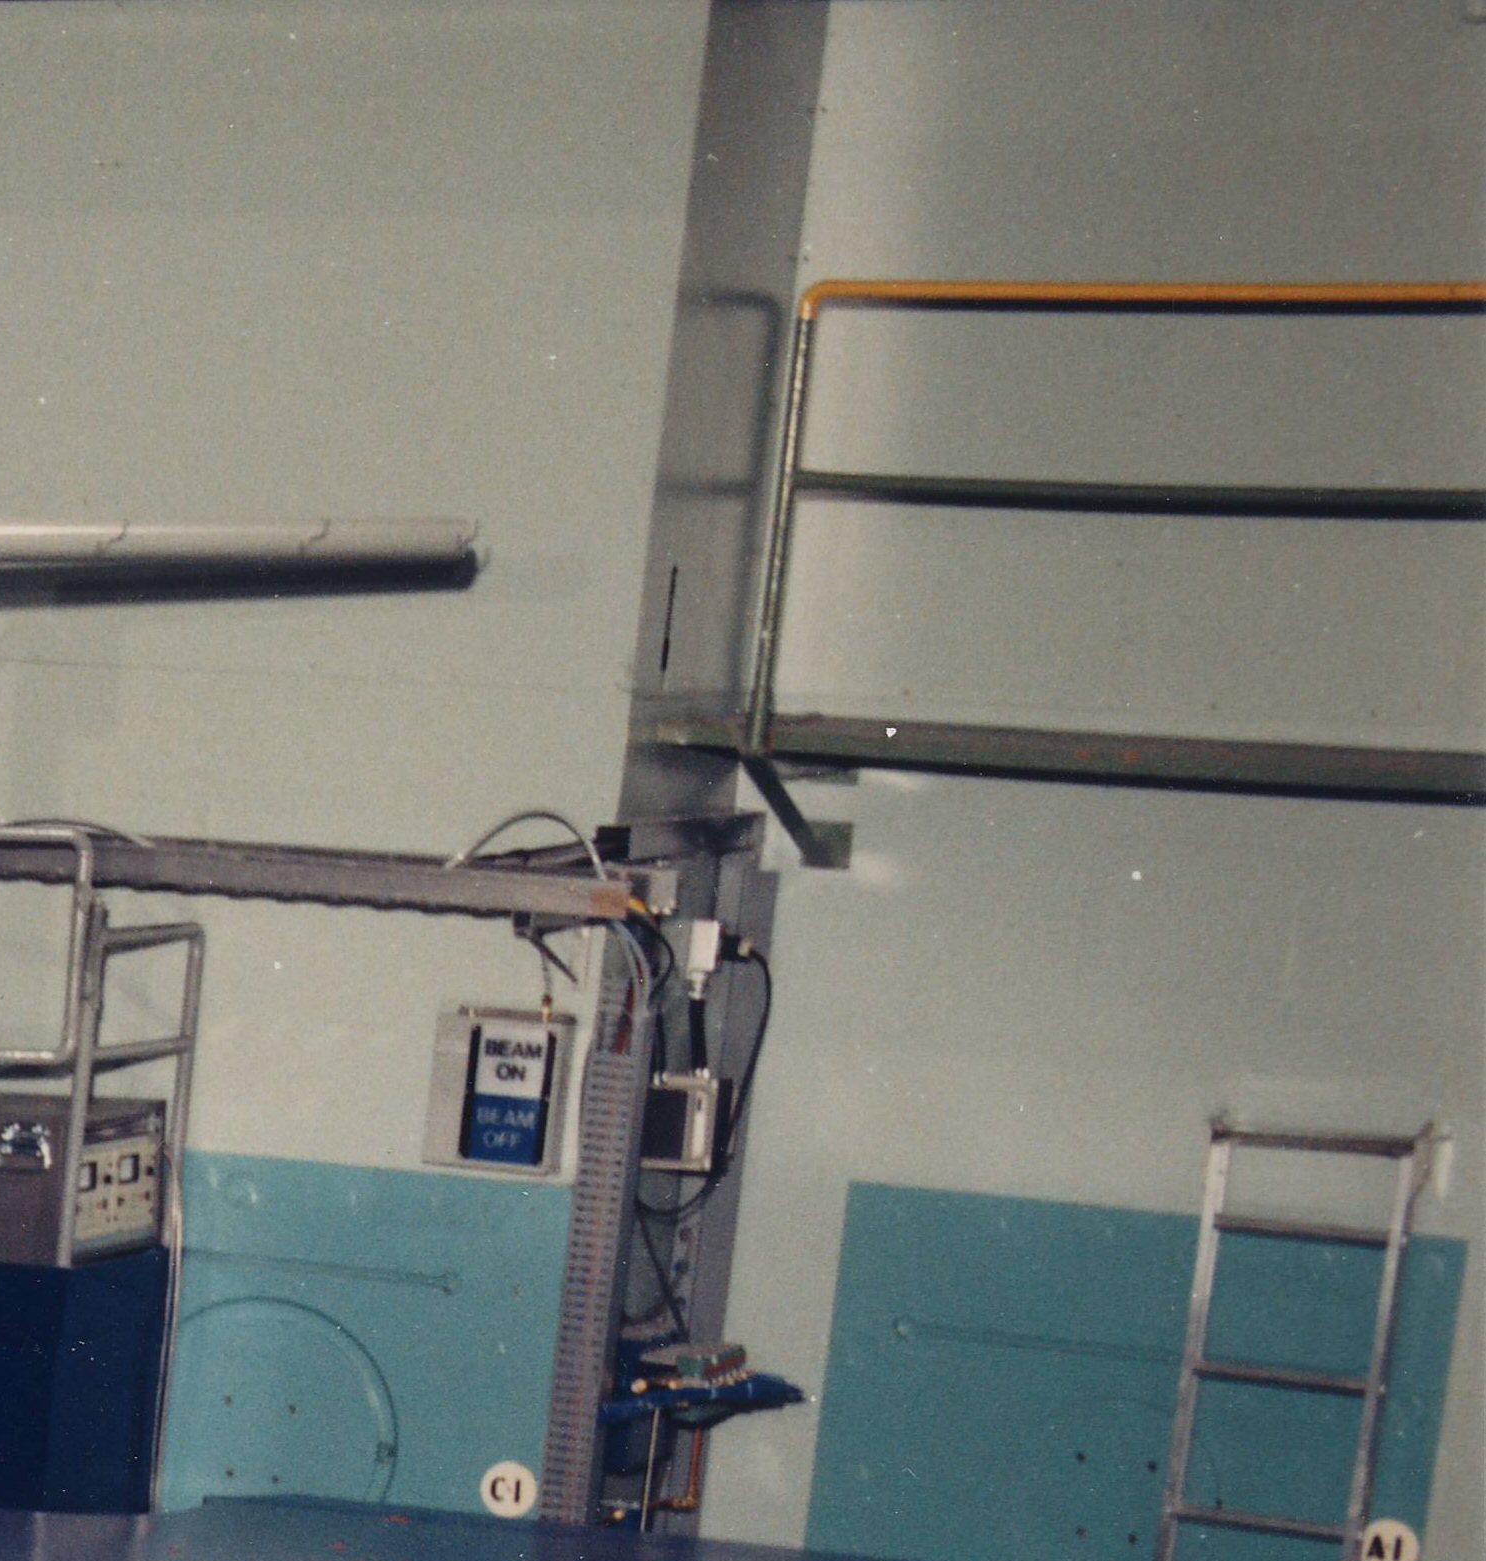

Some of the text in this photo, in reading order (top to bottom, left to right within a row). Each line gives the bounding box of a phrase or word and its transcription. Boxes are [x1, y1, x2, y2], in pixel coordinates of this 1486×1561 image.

[484, 1038, 543, 1058] BEAM
[495, 1063, 526, 1081] ON
[476, 1106, 536, 1129] BEAM
[482, 1131, 521, 1149] OFF
